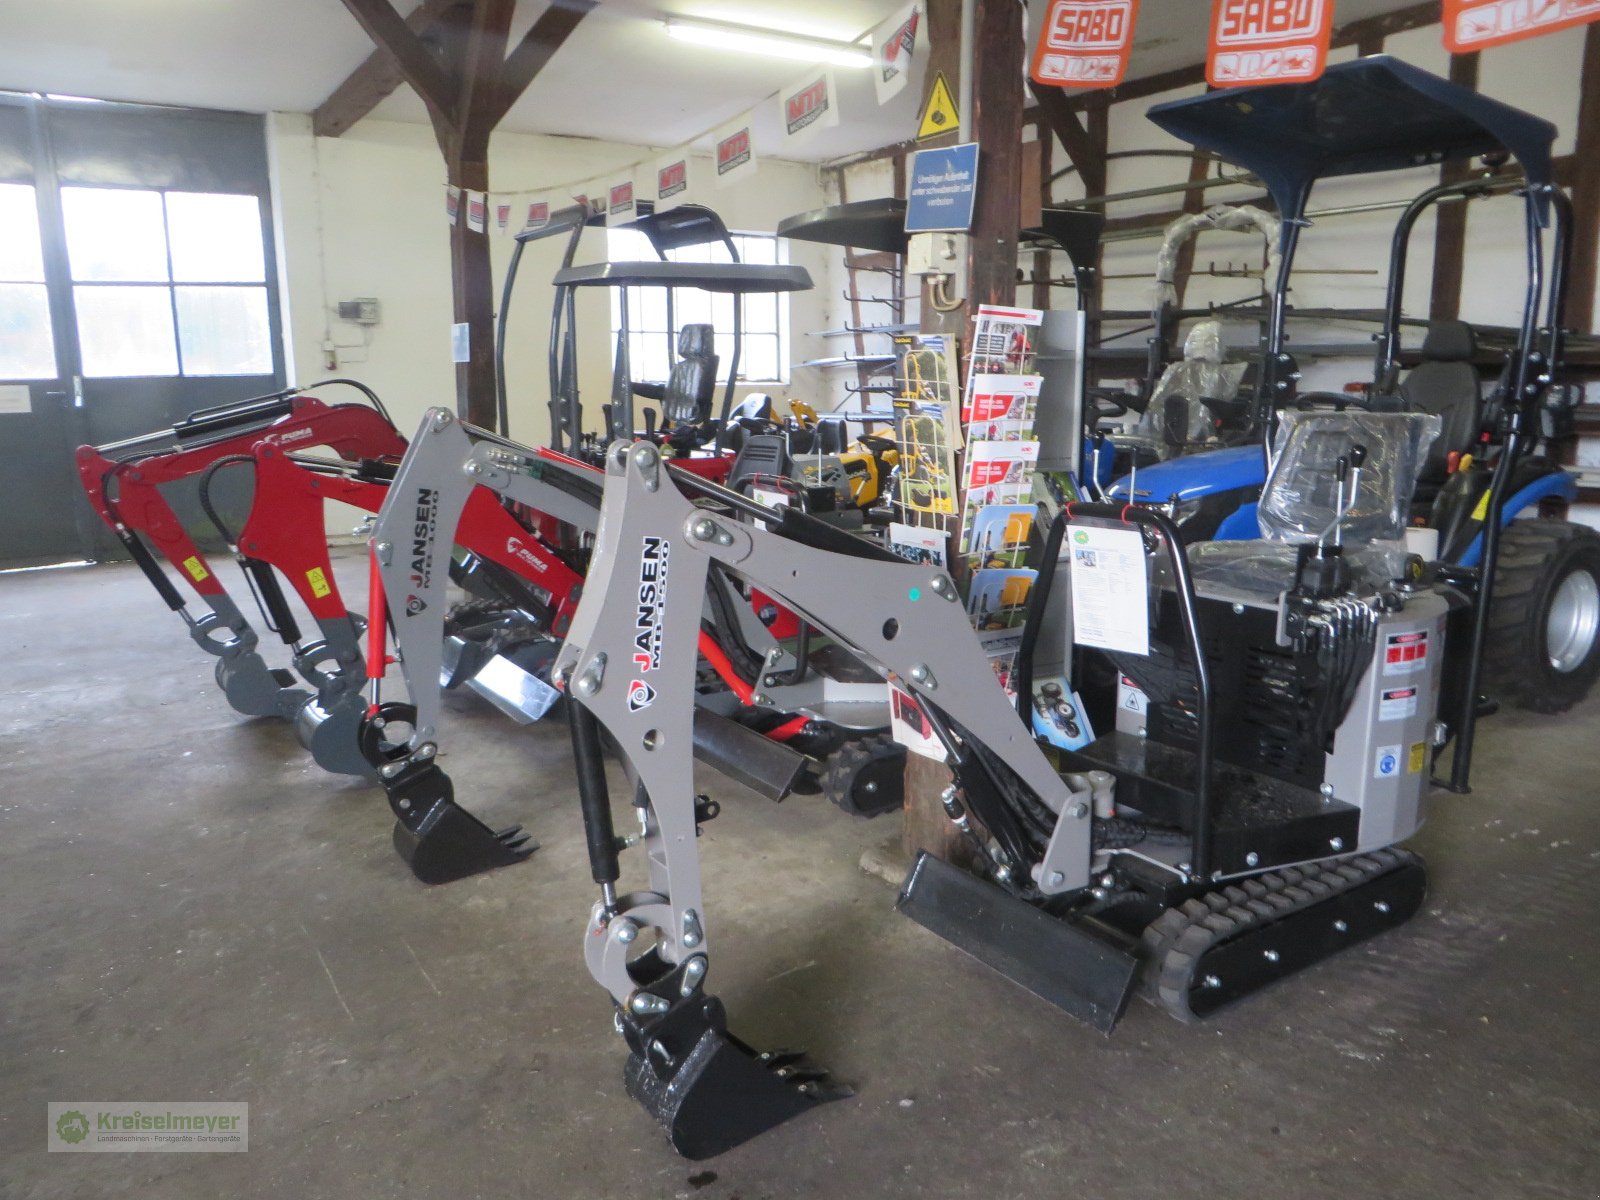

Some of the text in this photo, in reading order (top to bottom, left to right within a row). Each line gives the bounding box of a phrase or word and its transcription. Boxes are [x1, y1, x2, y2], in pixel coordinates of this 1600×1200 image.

[1053, 7, 1124, 42] SABO
[1222, 0, 1312, 37] SABO
[410, 488, 432, 589] JANSEN
[634, 536, 662, 672] JANSEN
[652, 540, 670, 669] MB 1500
